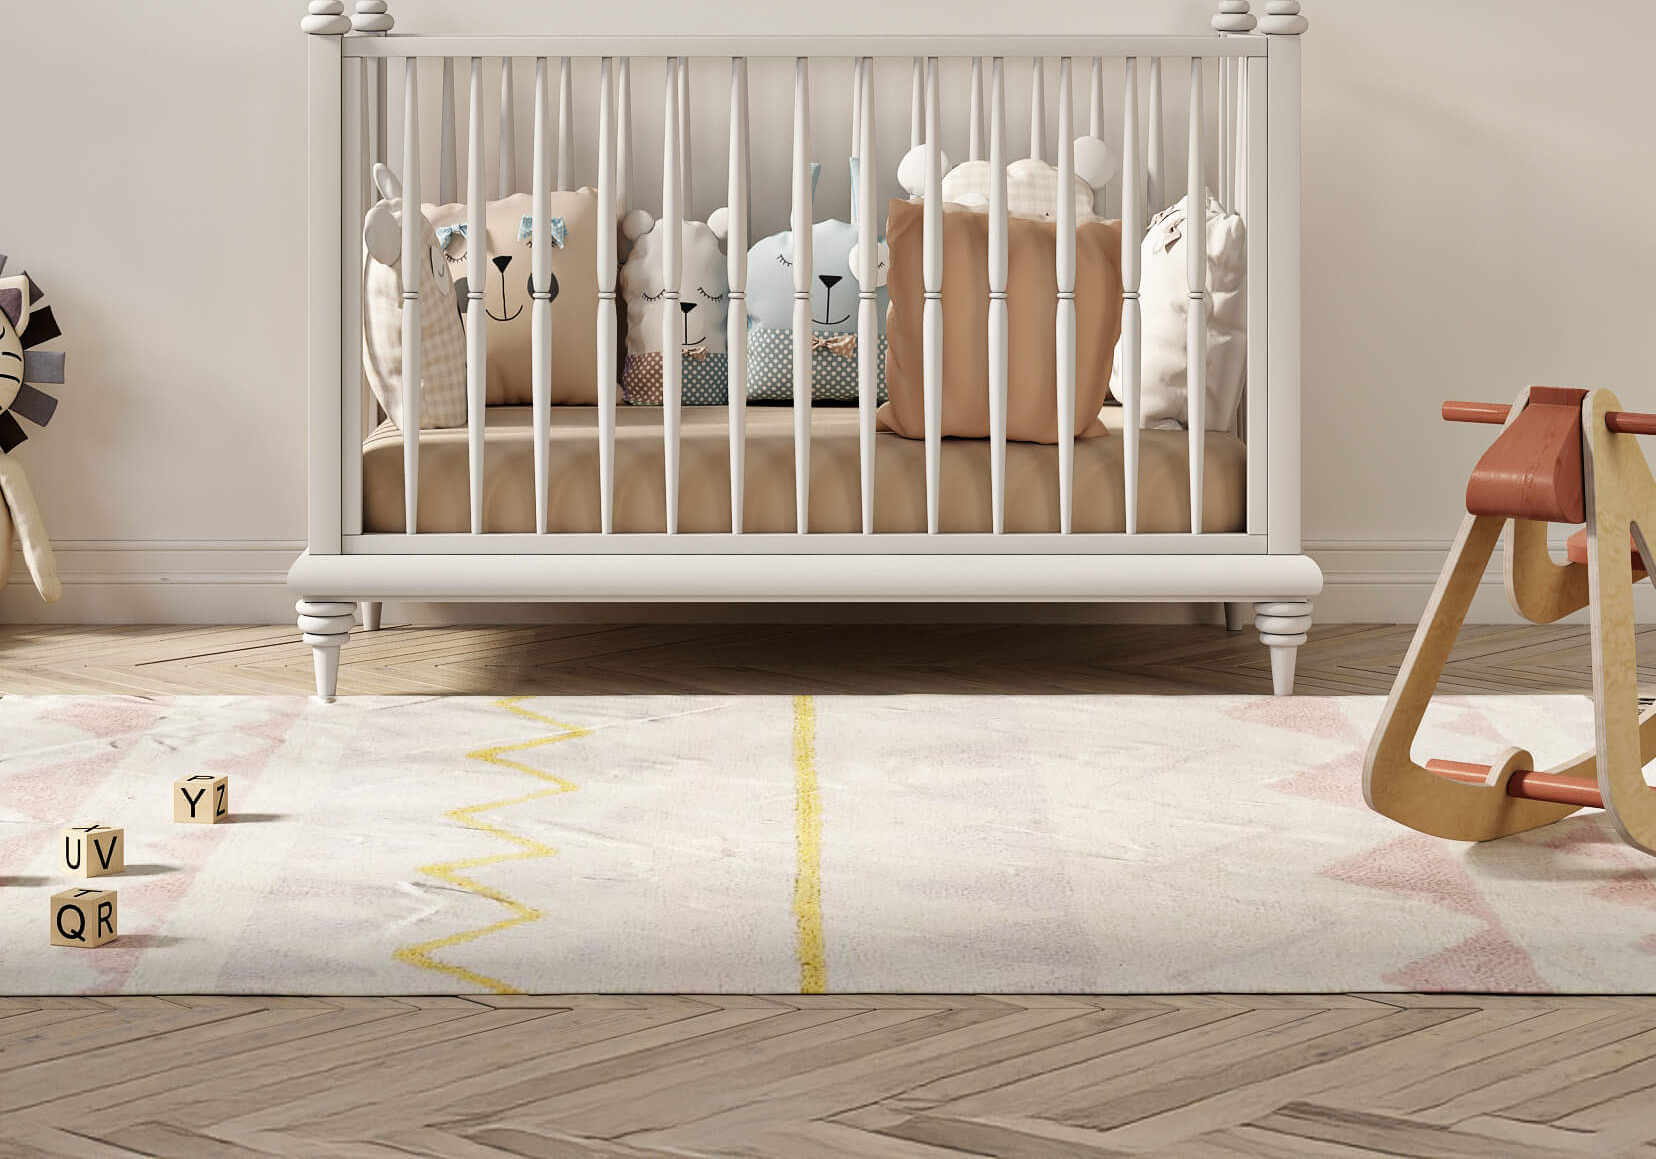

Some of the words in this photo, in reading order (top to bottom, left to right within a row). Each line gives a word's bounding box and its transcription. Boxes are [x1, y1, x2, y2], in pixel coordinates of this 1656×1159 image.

[180, 787, 206, 817] Y
[216, 783, 226, 817] Z
[65, 836, 81, 869] U
[93, 836, 117, 869] V
[56, 904, 86, 942] Q
[98, 901, 113, 938] R
